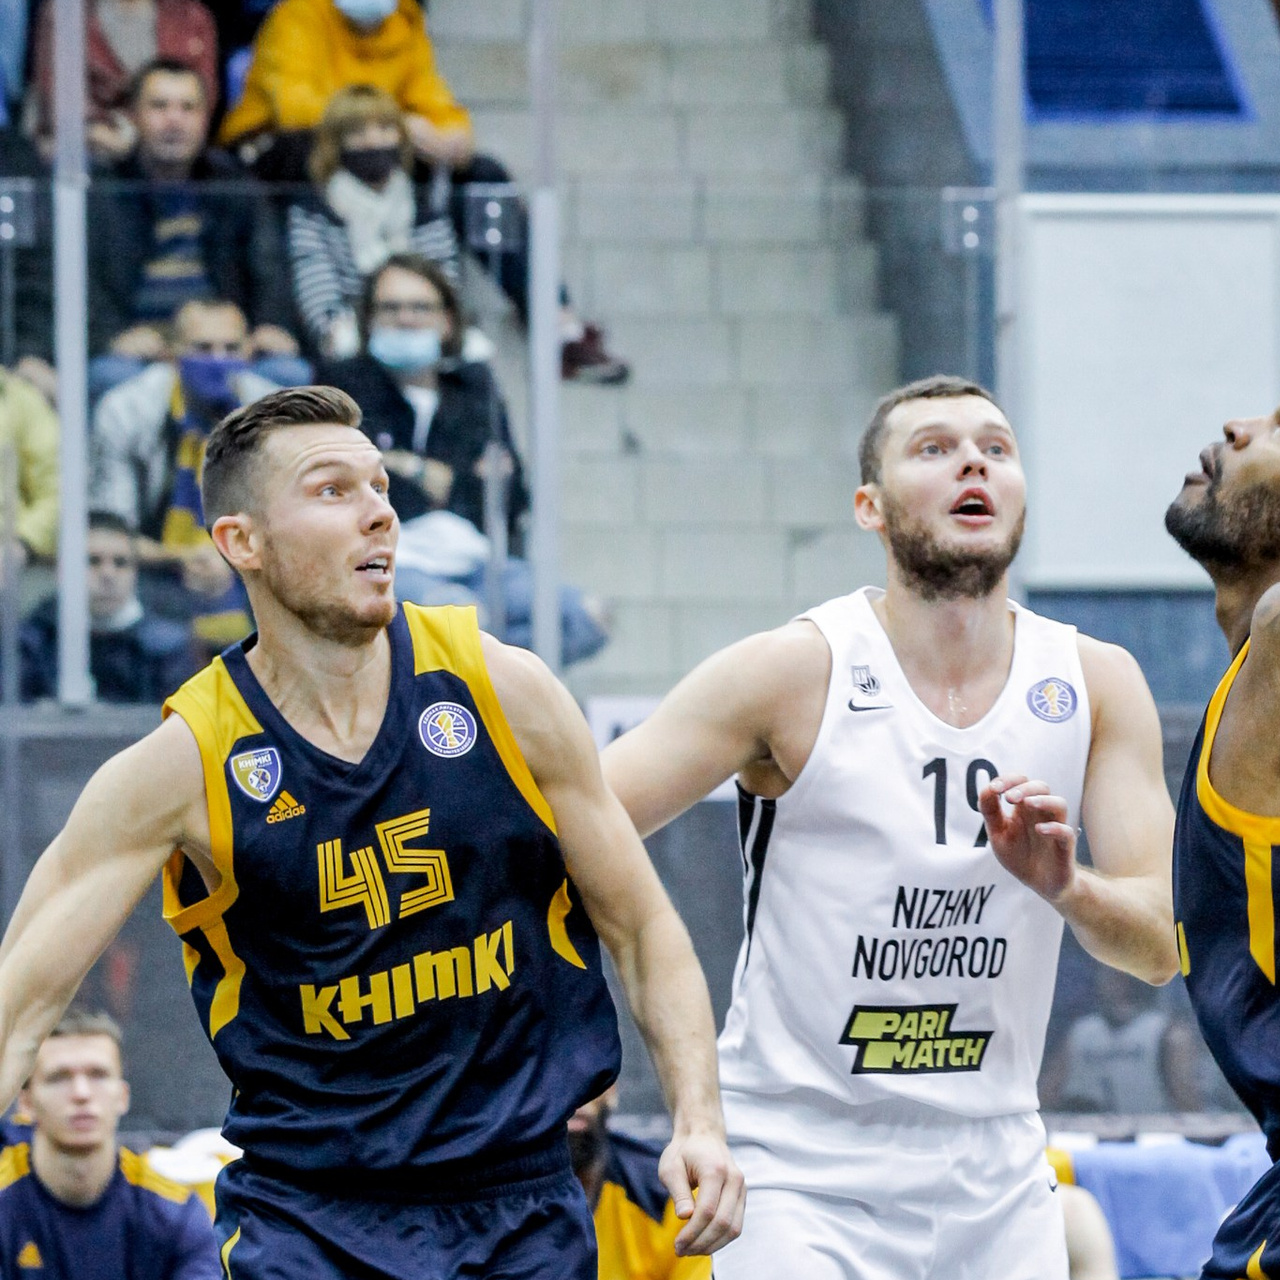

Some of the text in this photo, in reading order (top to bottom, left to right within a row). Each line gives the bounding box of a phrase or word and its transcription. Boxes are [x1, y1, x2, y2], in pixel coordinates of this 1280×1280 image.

[238, 753, 272, 769] KHIMKI
[266, 804, 306, 824] adidas
[316, 808, 455, 930] 45
[891, 884, 995, 929] NIZHNY
[851, 935, 1008, 981] NOVGOROD
[300, 920, 514, 1040] KHIMKI
[850, 1011, 948, 1040] PARI
[863, 1037, 986, 1069] MATCH
